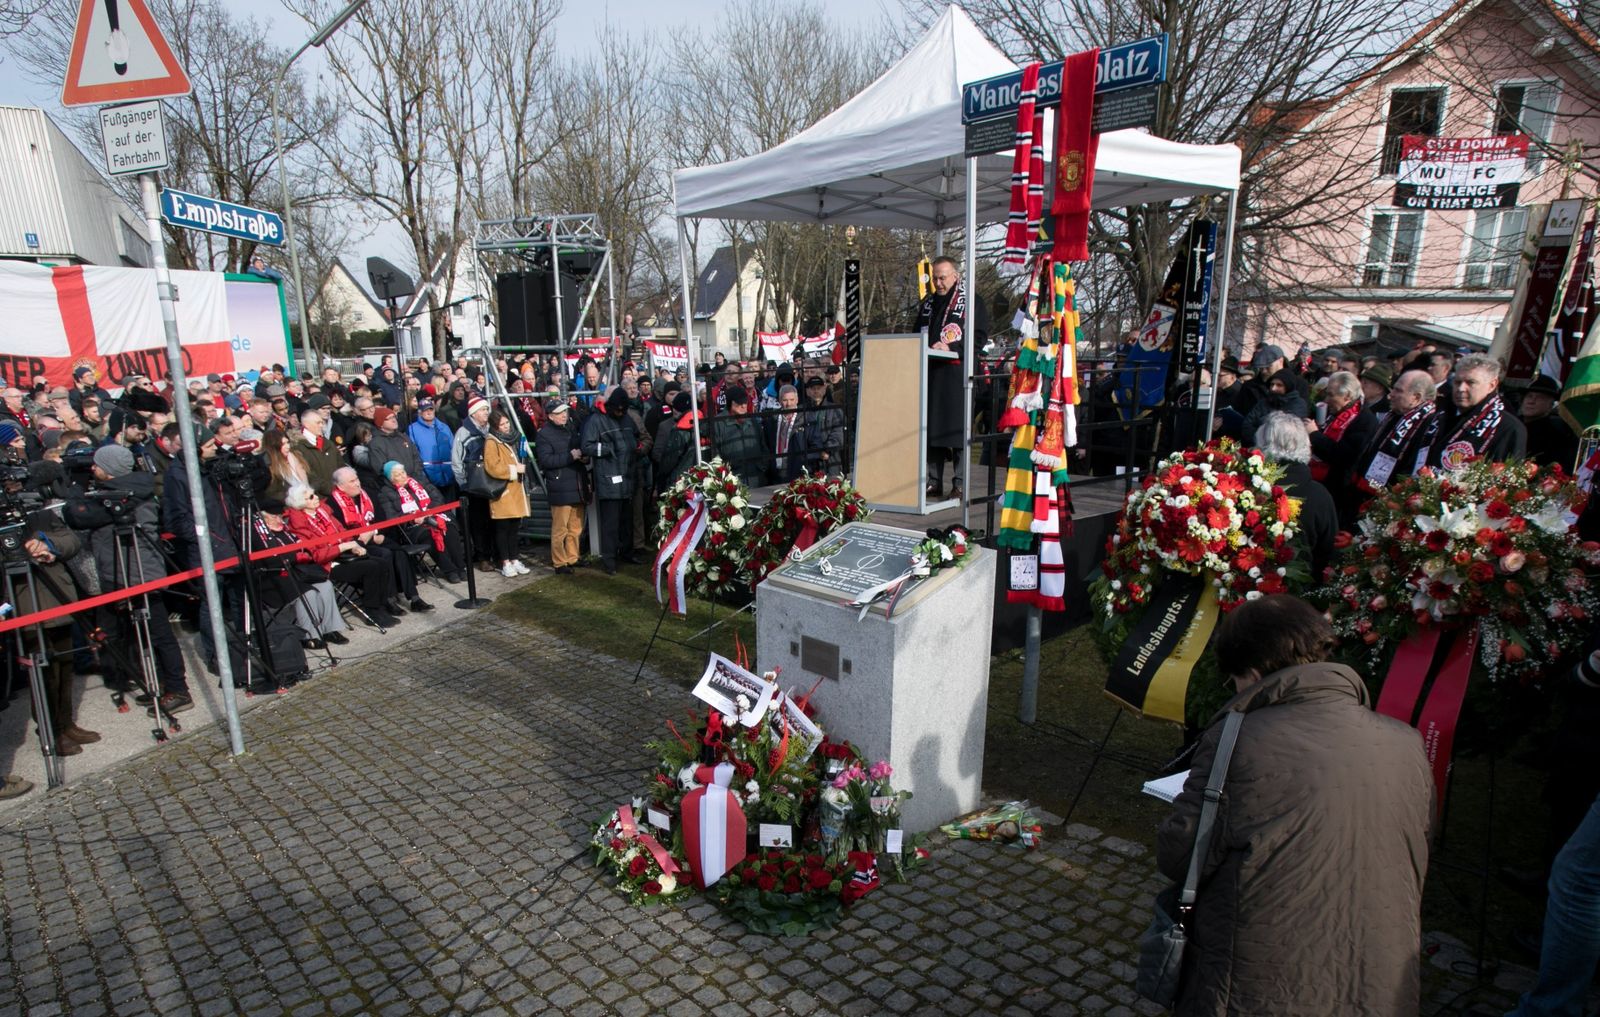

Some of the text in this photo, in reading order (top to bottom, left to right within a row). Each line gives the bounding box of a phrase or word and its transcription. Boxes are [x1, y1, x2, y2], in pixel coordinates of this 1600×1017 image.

[102, 109, 158, 128] Fußgänger
[115, 131, 152, 147] auf der
[1427, 138, 1507, 149] CUT DOWN
[112, 149, 161, 167] Fahrbahn
[1416, 185, 1497, 197] IN SILENCE
[1406, 196, 1503, 209] ON THAT DAY
[170, 192, 278, 240] Emplstraße
[655, 344, 687, 358] MUFC
[105, 345, 193, 386] UNITD
